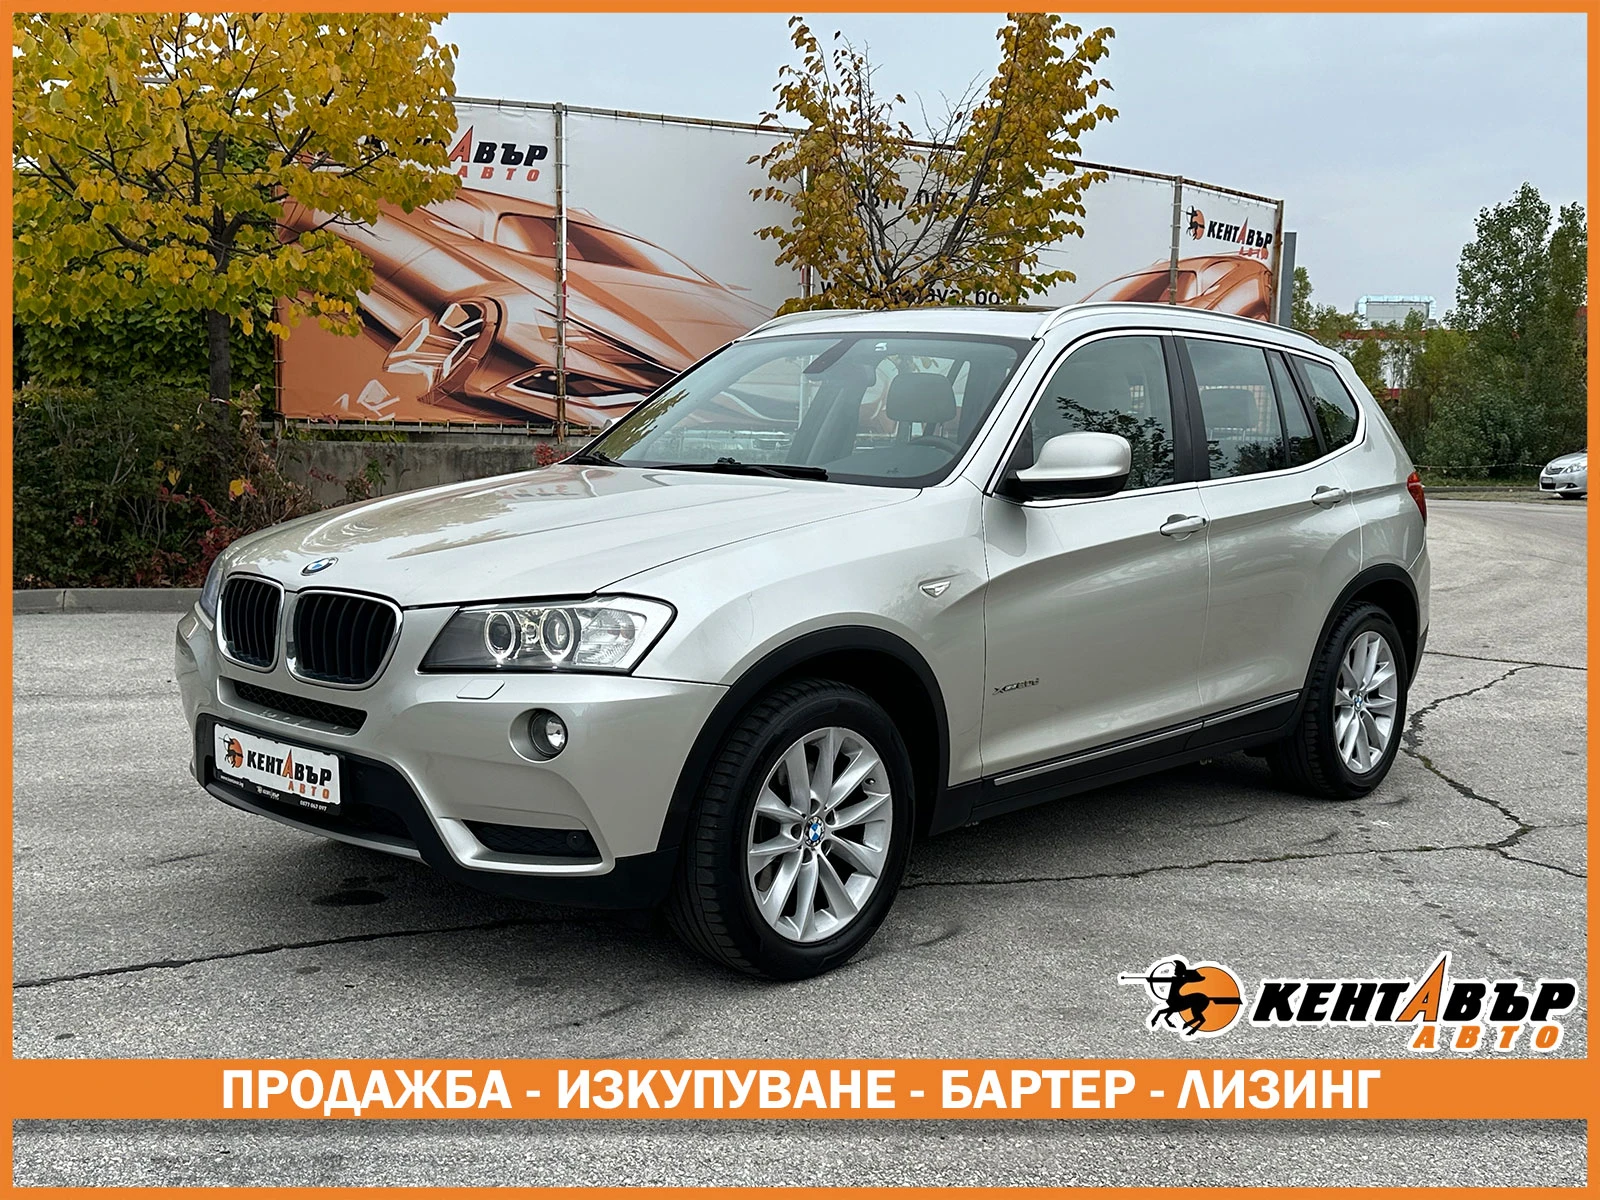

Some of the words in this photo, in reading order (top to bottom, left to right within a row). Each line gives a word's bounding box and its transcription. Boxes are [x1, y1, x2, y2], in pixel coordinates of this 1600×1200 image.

[456, 165, 540, 182] АВТО
[1206, 217, 1273, 249] КЕНТАВЪР
[247, 748, 332, 787] КЕНТАВЪР
[288, 780, 330, 799] АВТО
